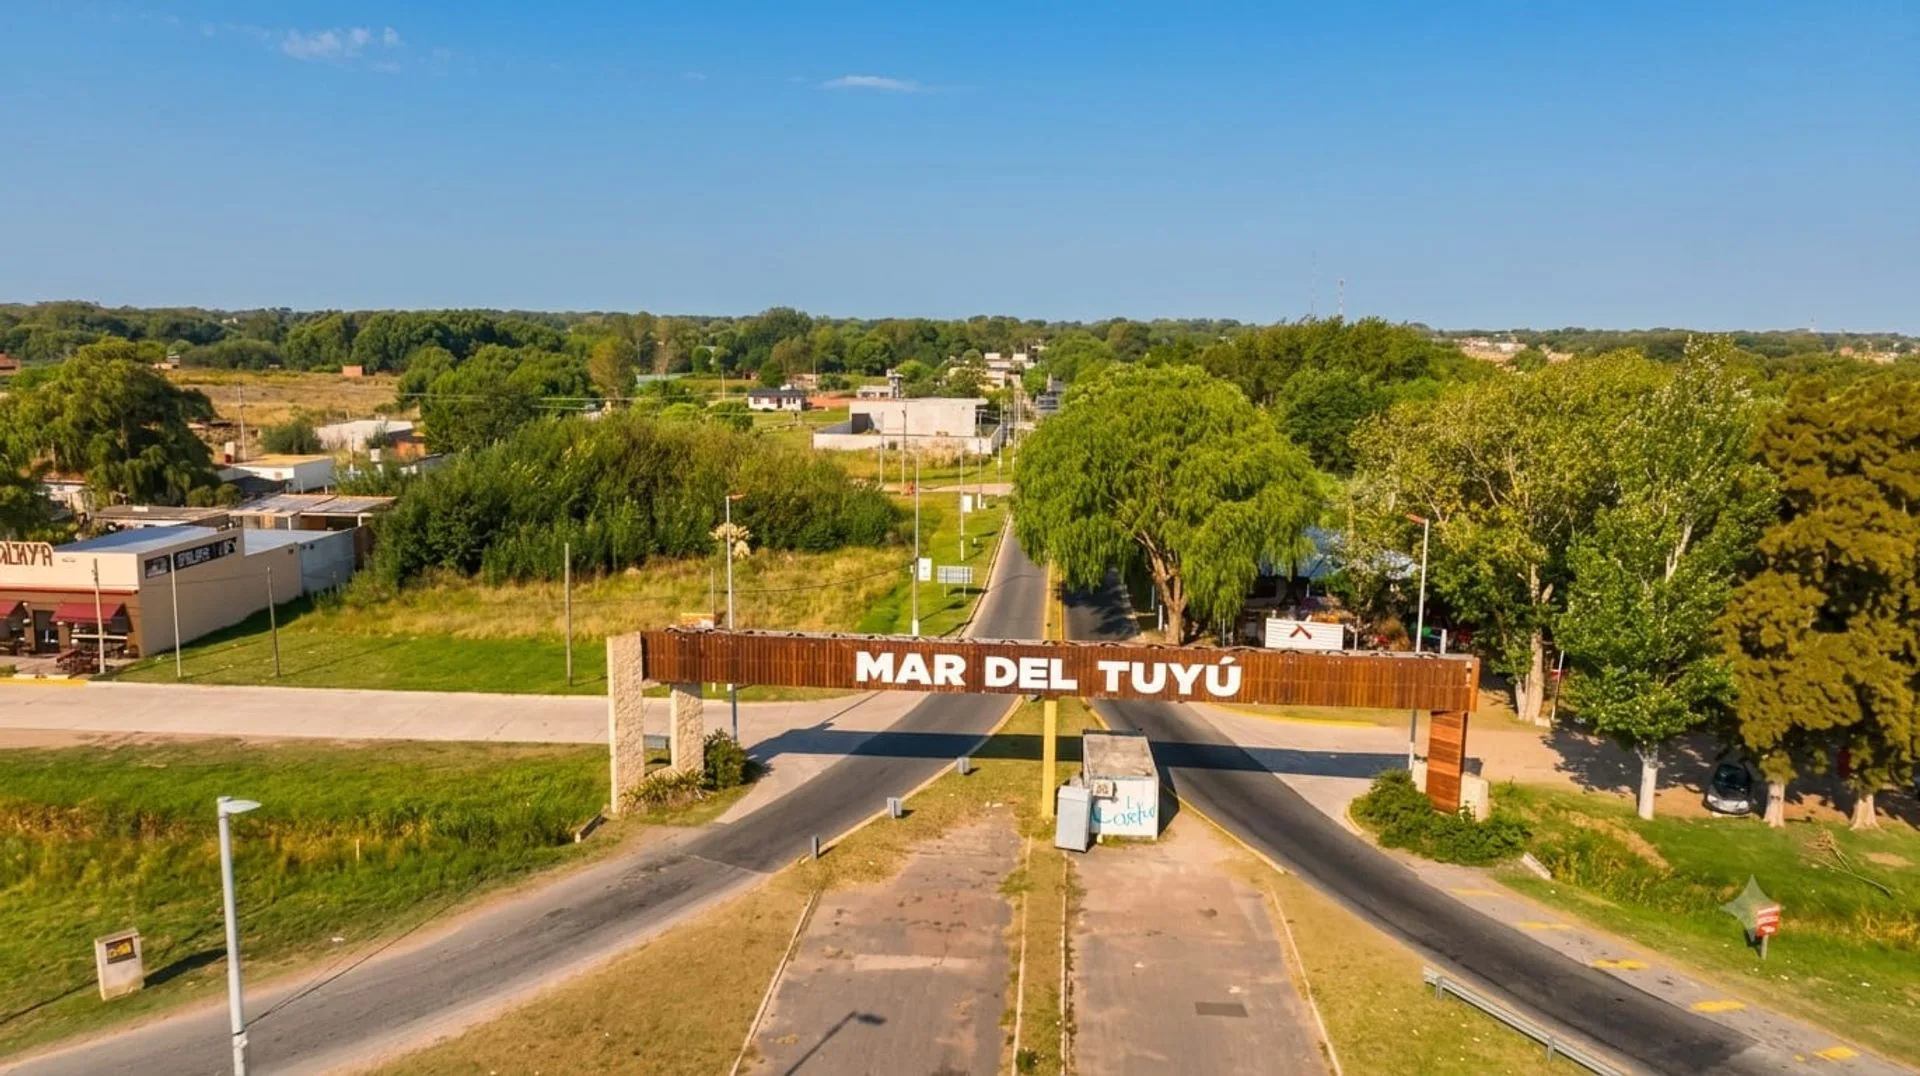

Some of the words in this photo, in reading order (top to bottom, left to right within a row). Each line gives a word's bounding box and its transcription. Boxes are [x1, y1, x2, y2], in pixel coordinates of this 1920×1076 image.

[855, 651, 967, 687] MAR
[984, 656, 1078, 690] DEL
[1097, 655, 1242, 697] TUYÚ
